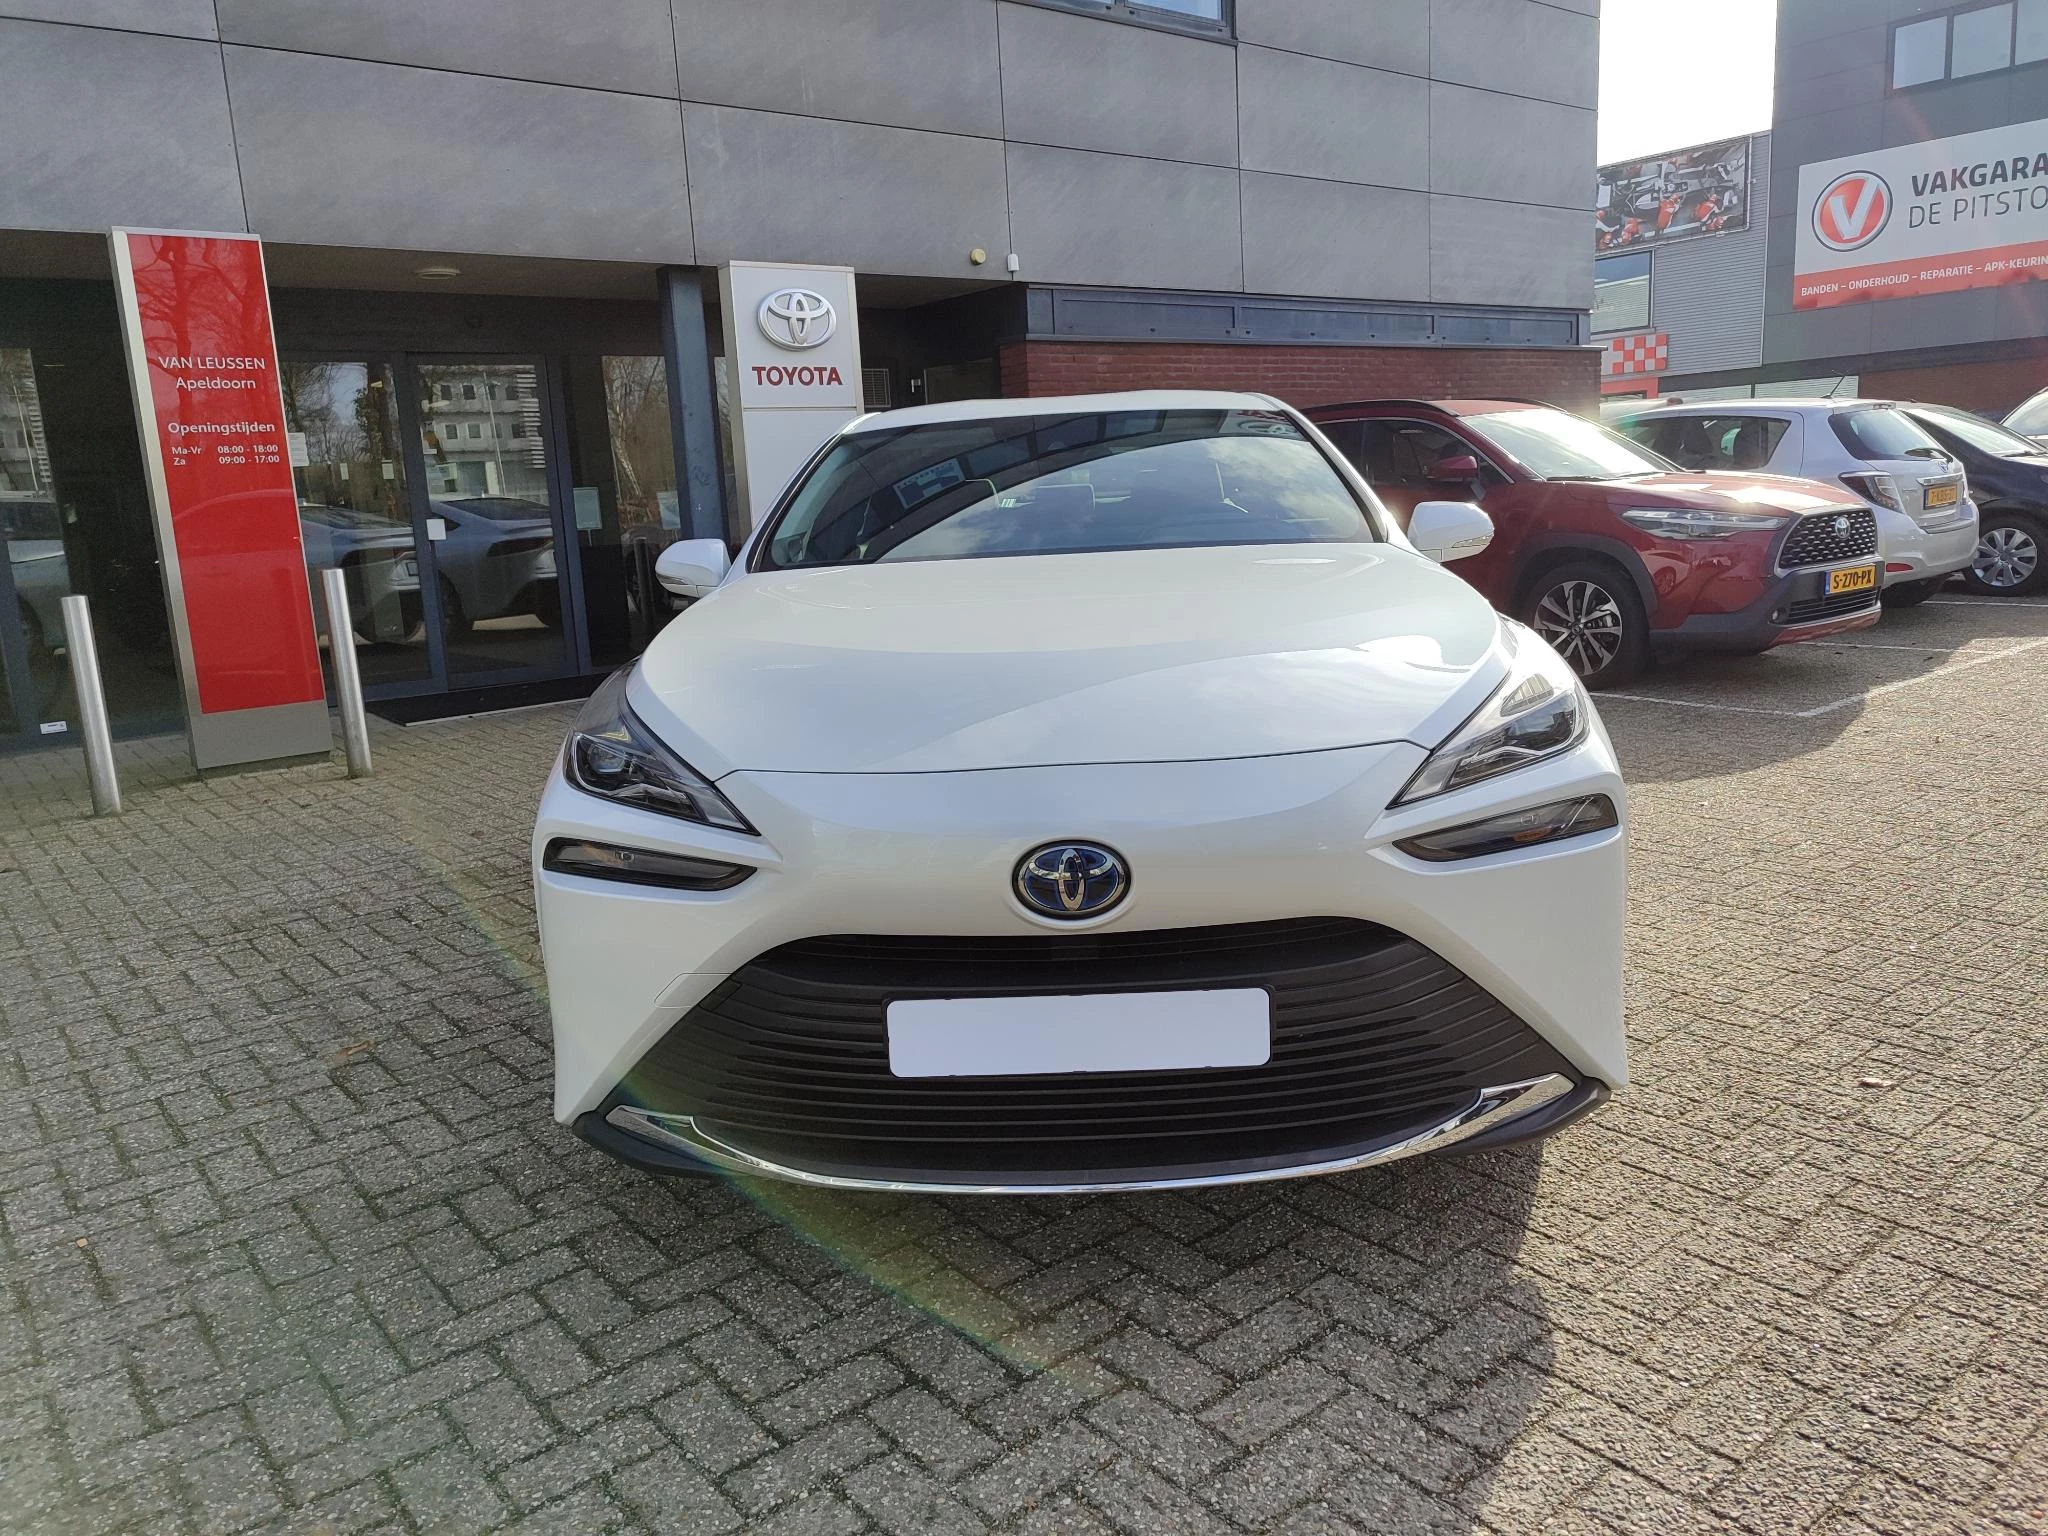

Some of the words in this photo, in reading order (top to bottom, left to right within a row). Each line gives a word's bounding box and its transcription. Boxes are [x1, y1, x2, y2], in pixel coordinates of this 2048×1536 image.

[1911, 152, 2048, 197] VAKGARA
[1909, 201, 1942, 228] DE
[1953, 185, 2048, 221] PITSTO
[1801, 283, 1838, 296] BANDEN
[1848, 273, 1909, 290] ONDERHOUD
[1920, 264, 1973, 280] REPARATIE
[158, 357, 193, 369] VAN
[198, 357, 266, 370] LEUSSEN
[176, 376, 256, 392] Apeldoorn
[751, 366, 843, 386] TOYOTA
[168, 421, 275, 436] Openingstijden
[171, 446, 202, 455] Ma-Vr
[217, 445, 244, 454] 08:00
[253, 444, 278, 453] 18:00
[173, 457, 186, 466] Za
[219, 456, 245, 464] 09:00
[254, 455, 280, 463] 17:00
[1833, 569, 1872, 590] S-270-PX
